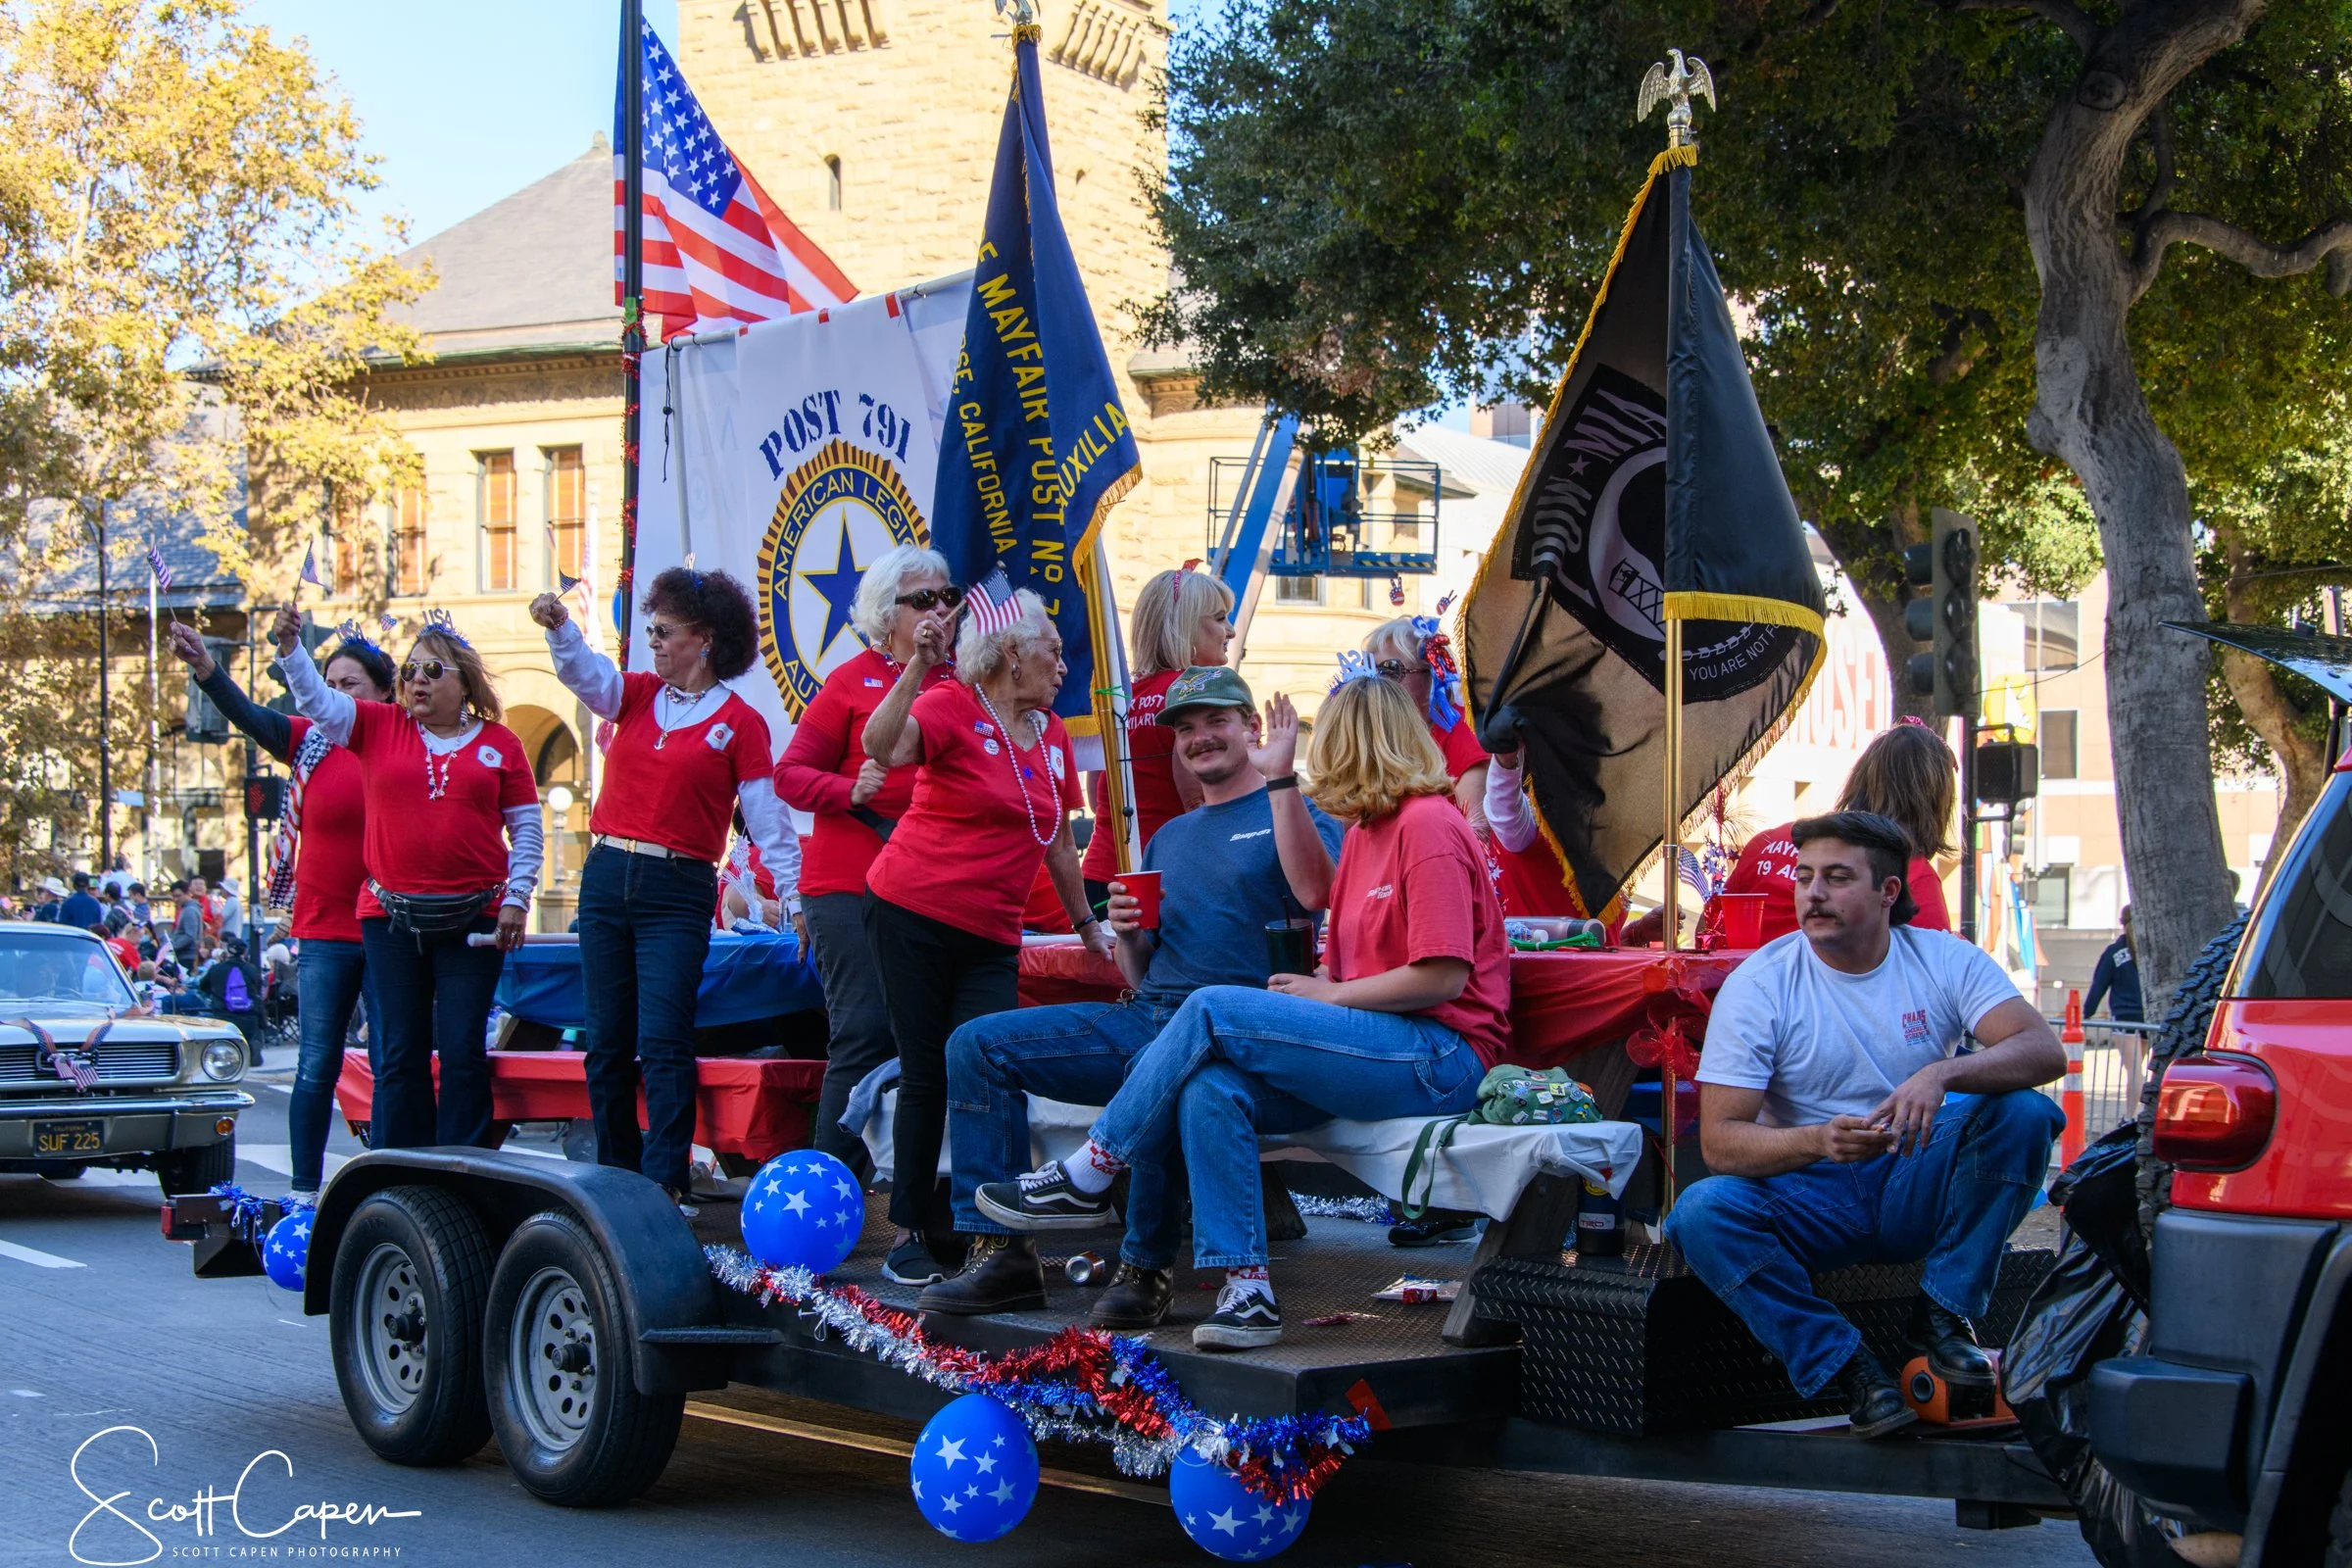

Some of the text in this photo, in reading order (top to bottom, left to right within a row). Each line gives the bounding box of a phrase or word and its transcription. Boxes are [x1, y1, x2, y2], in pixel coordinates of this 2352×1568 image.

[977, 272, 1050, 421] MAYFAIR
[760, 389, 841, 481] POST
[858, 391, 911, 464] 791
[958, 402, 1017, 554] CALIFORNIA
[774, 471, 854, 601] AMERICAN
[1138, 694, 1164, 710] POST
[1690, 664, 1718, 681] YOU
[1721, 653, 1747, 676] ARE
[1745, 633, 1769, 661] NOT
[39, 1132, 101, 1152] SUF 225
